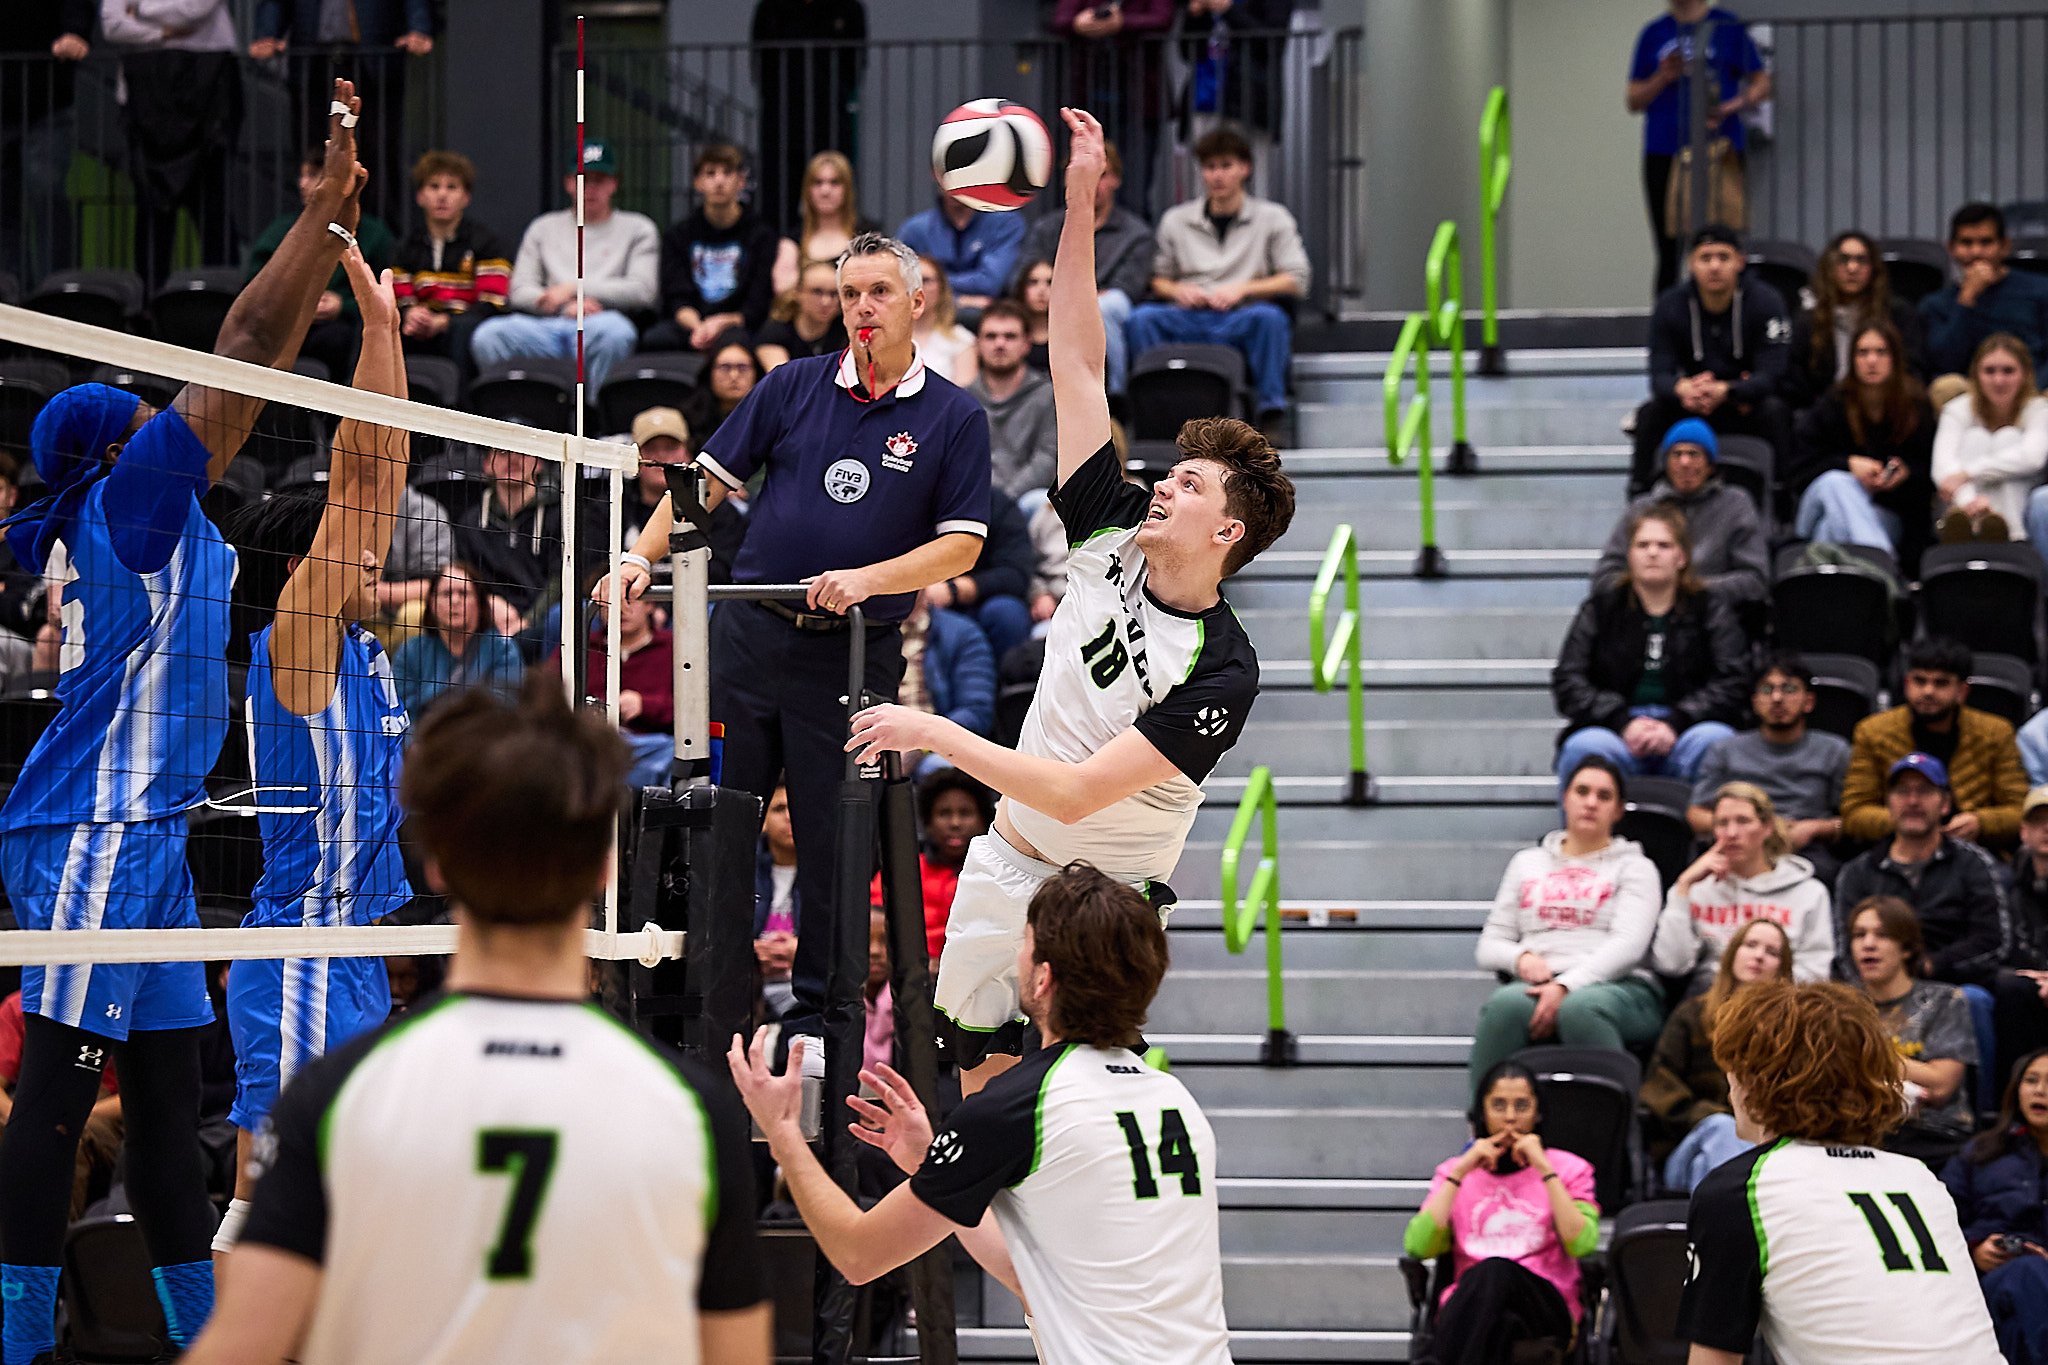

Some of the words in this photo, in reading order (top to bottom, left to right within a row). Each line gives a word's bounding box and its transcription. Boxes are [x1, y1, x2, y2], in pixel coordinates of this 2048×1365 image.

[835, 468, 862, 483] FIVB
[1080, 617, 1129, 690] 18
[1114, 1107, 1202, 1200] 14
[475, 1126, 560, 1282] 7
[1845, 1190, 1951, 1273] 11
